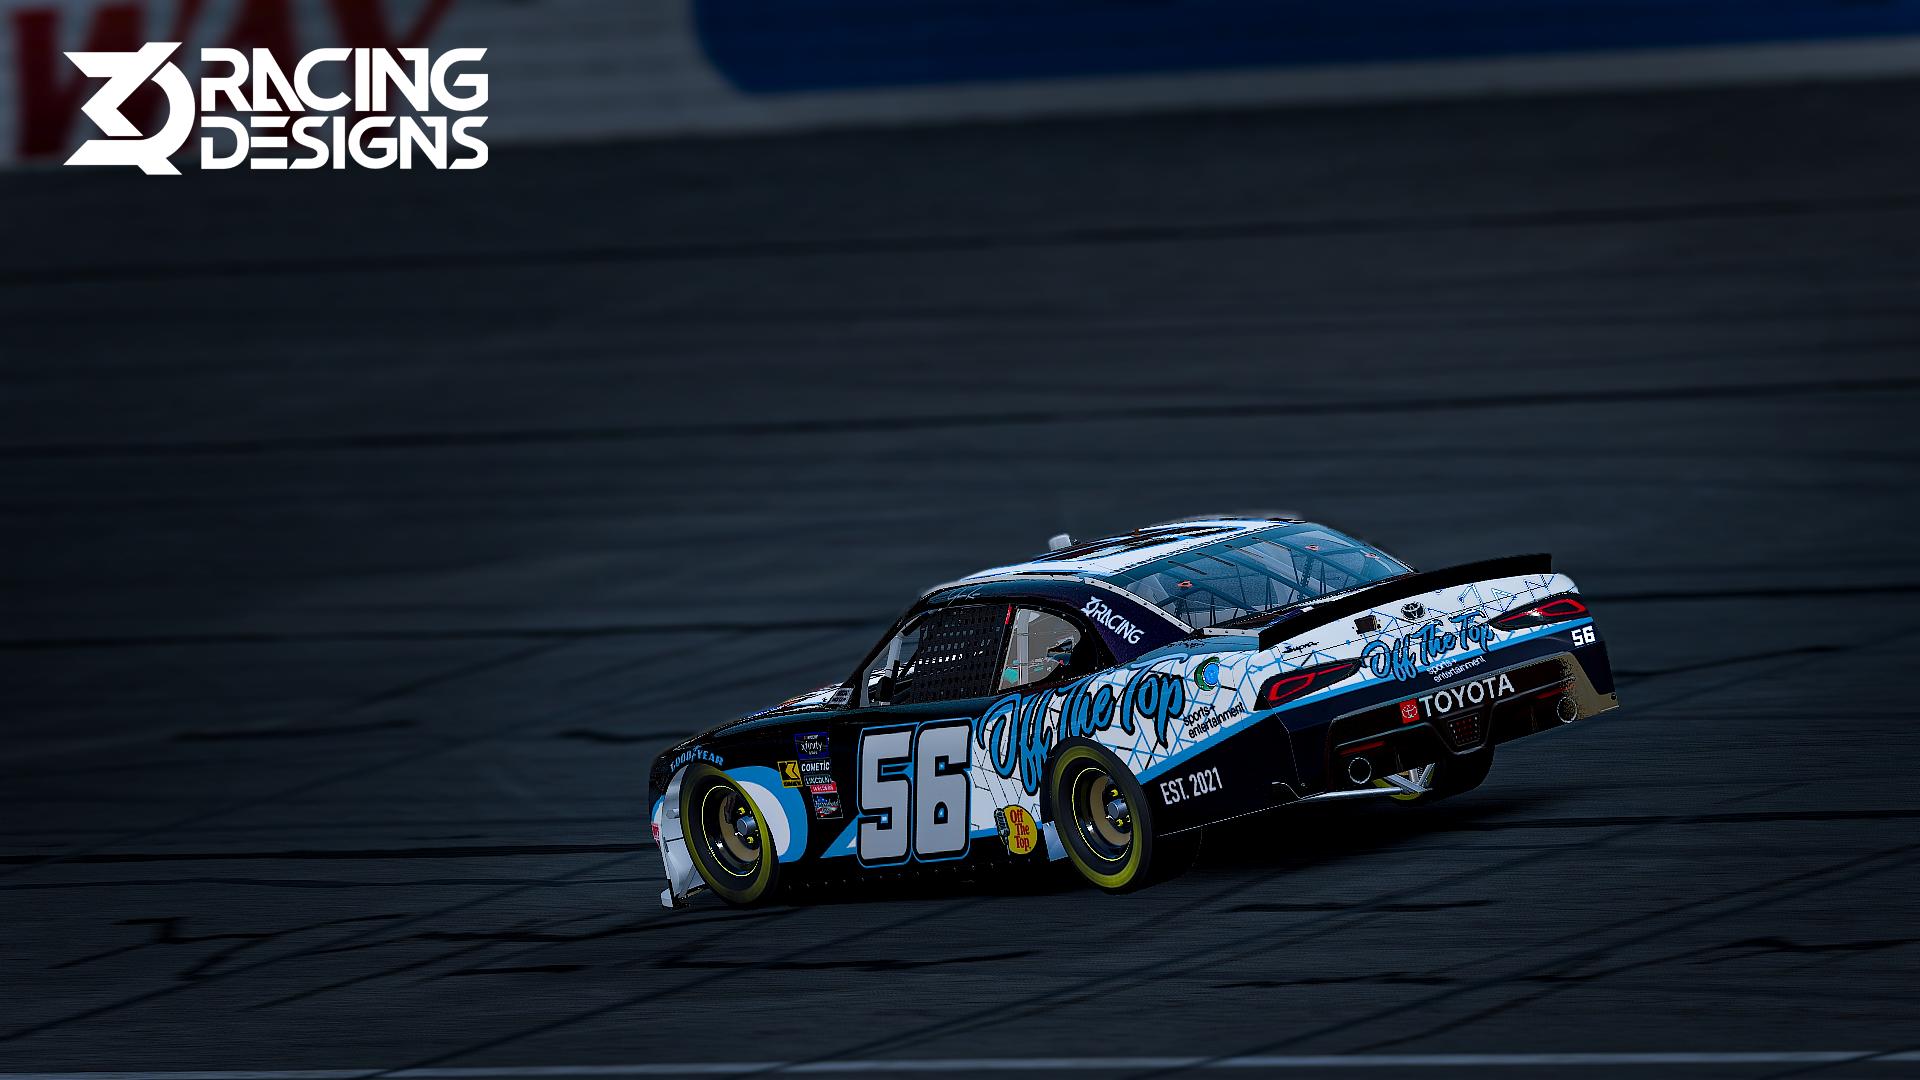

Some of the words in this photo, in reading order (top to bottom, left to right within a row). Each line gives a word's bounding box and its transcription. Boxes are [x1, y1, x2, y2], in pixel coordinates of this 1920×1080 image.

[1361, 633, 1418, 681] Off
[1409, 619, 1458, 666] The
[1448, 610, 1495, 652] Top
[1571, 625, 1596, 647] 56
[1418, 673, 1515, 718] TOYOTA
[976, 688, 1054, 796] Off
[1054, 671, 1117, 745] The
[1118, 652, 1189, 749] Top
[1188, 701, 1246, 738] entertainment
[858, 718, 973, 866] 56
[1160, 778, 1190, 805] EST.
[1189, 766, 1223, 797] 2021
[1009, 809, 1024, 823] Off
[1015, 823, 1030, 836] The
